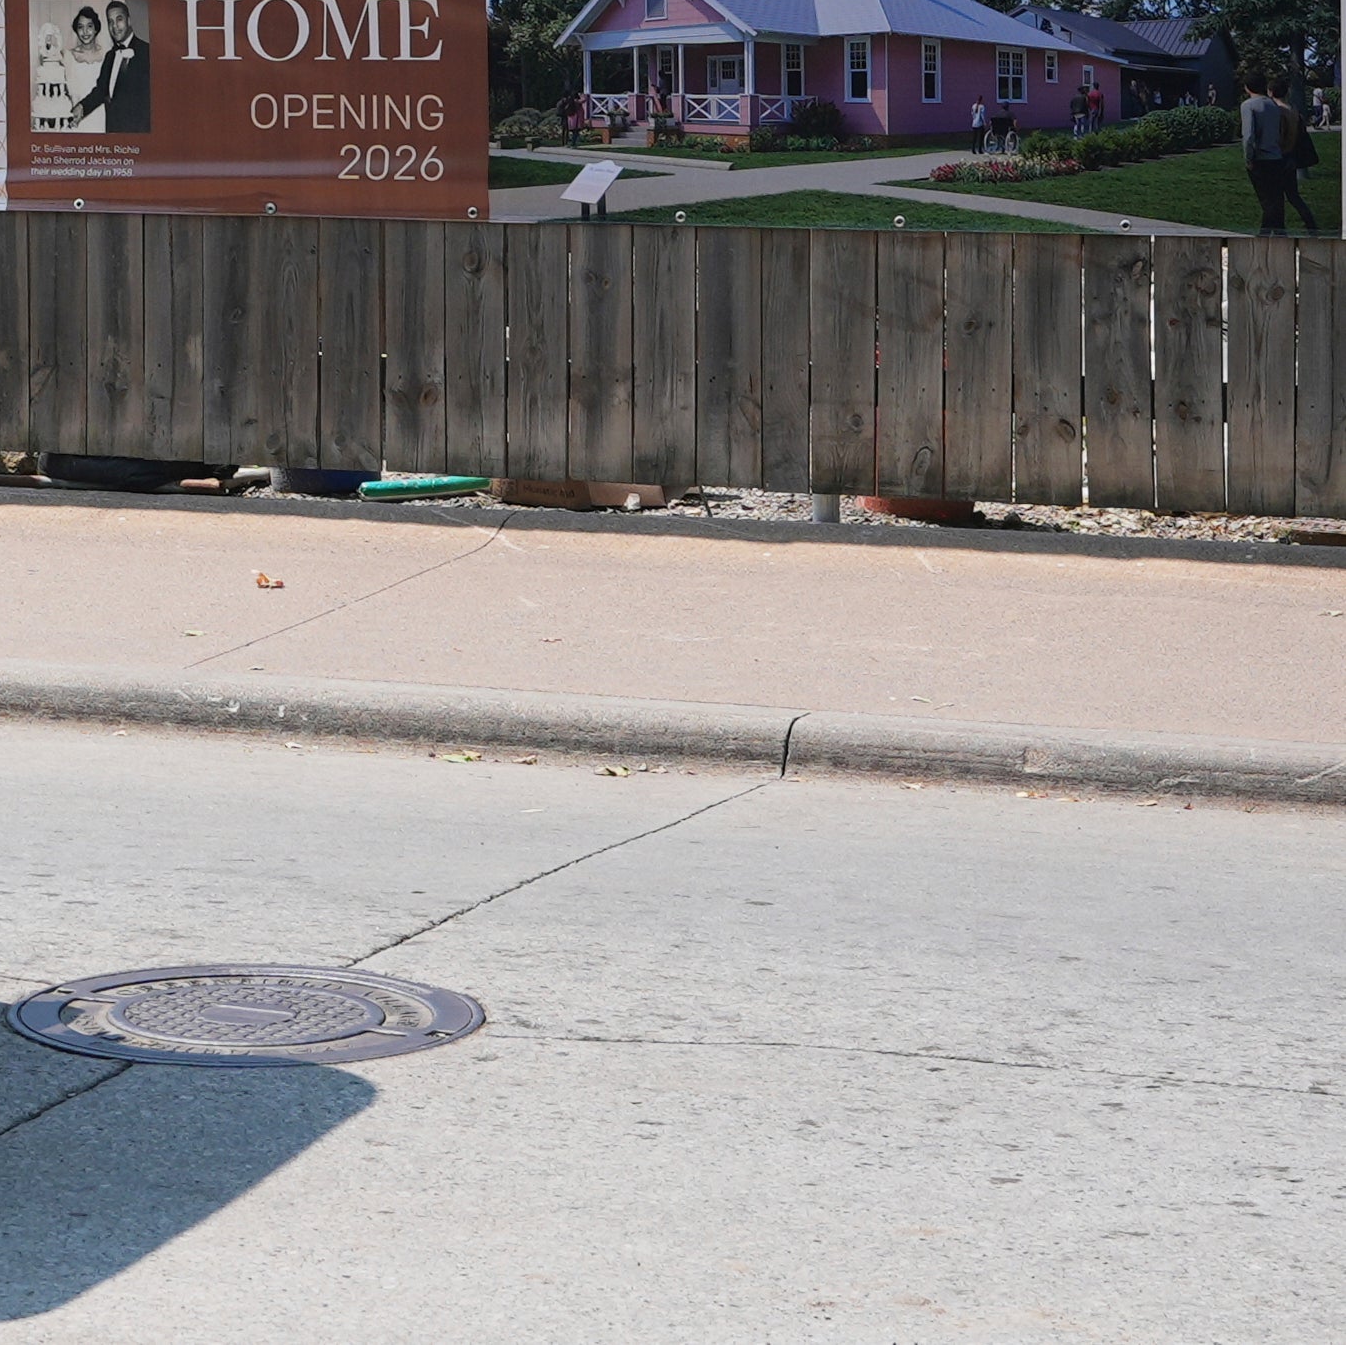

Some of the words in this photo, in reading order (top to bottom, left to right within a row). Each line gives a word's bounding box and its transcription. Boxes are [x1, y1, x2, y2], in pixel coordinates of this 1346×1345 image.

[250, 94, 445, 130] OPENING
[78, 145, 94, 154] and
[114, 145, 140, 154] Richie
[31, 156, 51, 165] Jean
[53, 156, 86, 165] Sherrod
[87, 157, 122, 166] Jackson
[338, 145, 444, 182] 2026
[51, 168, 86, 178] wedding
[86, 168, 102, 178] day
[103, 168, 111, 176] in
